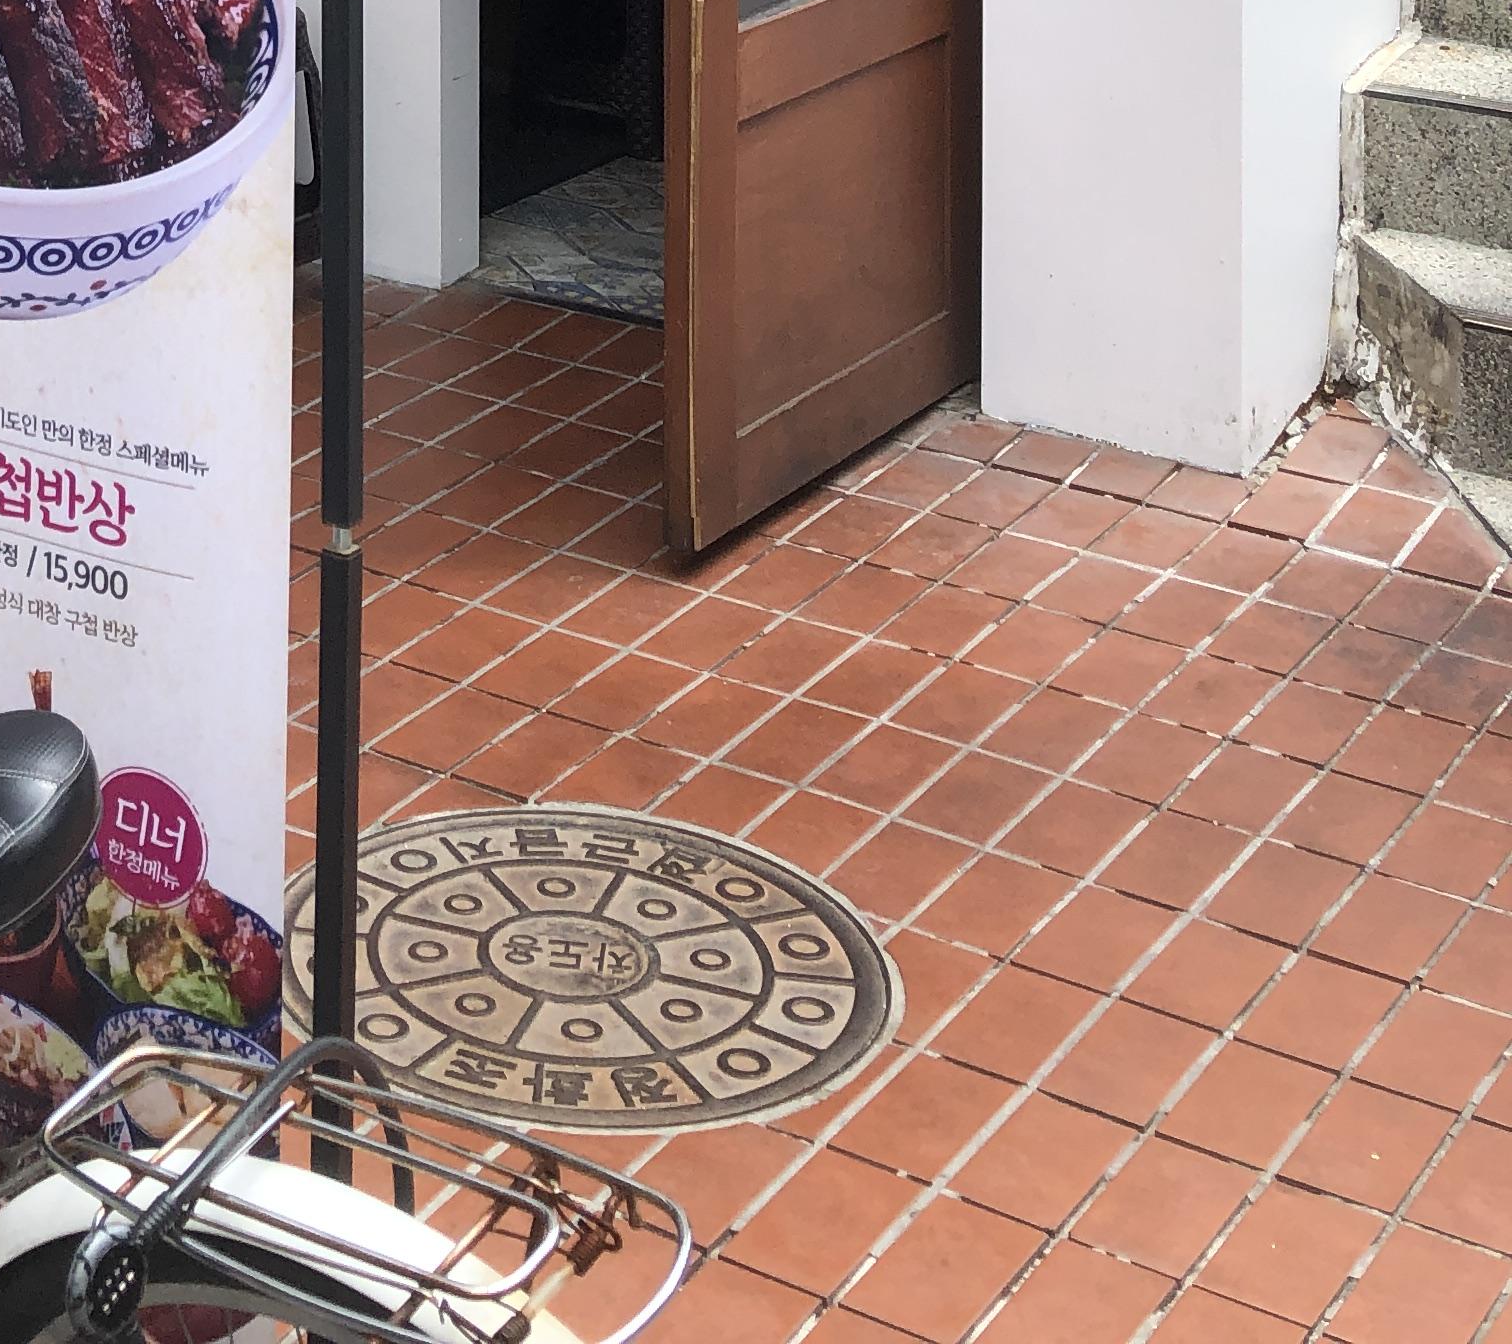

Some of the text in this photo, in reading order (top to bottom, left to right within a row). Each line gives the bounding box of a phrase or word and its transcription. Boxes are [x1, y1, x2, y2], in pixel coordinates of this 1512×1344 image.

[41, 419, 74, 446] 만의
[78, 428, 113, 457] 한정
[116, 440, 209, 478] 스페셜메뉴
[43, 550, 129, 601] 15,900
[28, 599, 61, 626] 대창
[65, 608, 98, 638] 구첩
[102, 620, 139, 649] 반상
[116, 797, 187, 864] 디너
[108, 838, 180, 891] 한정메뉴
[501, 933, 640, 986] 차도용
[444, 1048, 680, 1109] 정화조
